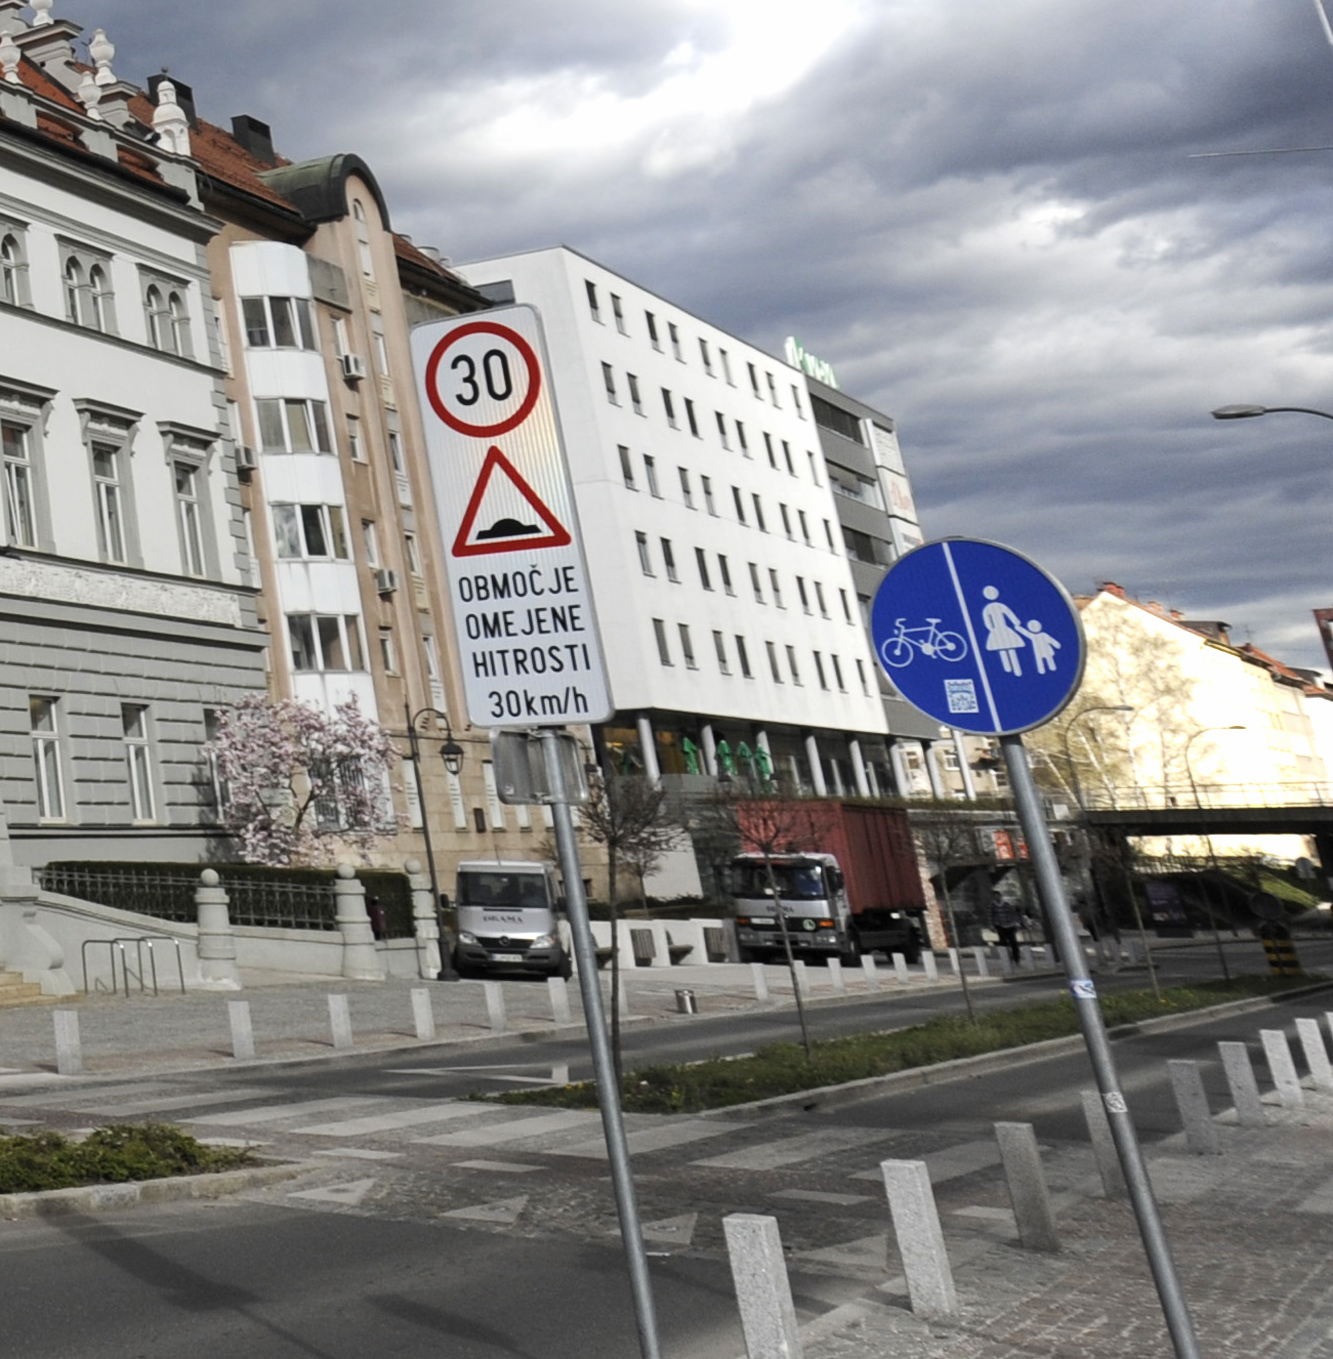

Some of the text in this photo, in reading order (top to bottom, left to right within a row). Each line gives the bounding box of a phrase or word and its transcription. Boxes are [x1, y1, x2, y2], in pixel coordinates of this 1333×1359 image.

[451, 349, 513, 406] 30
[459, 564, 579, 603] OBMOČJE
[465, 604, 585, 640] OMEJENE
[472, 643, 591, 678] HITROSTI
[488, 686, 589, 719] 30km/h
